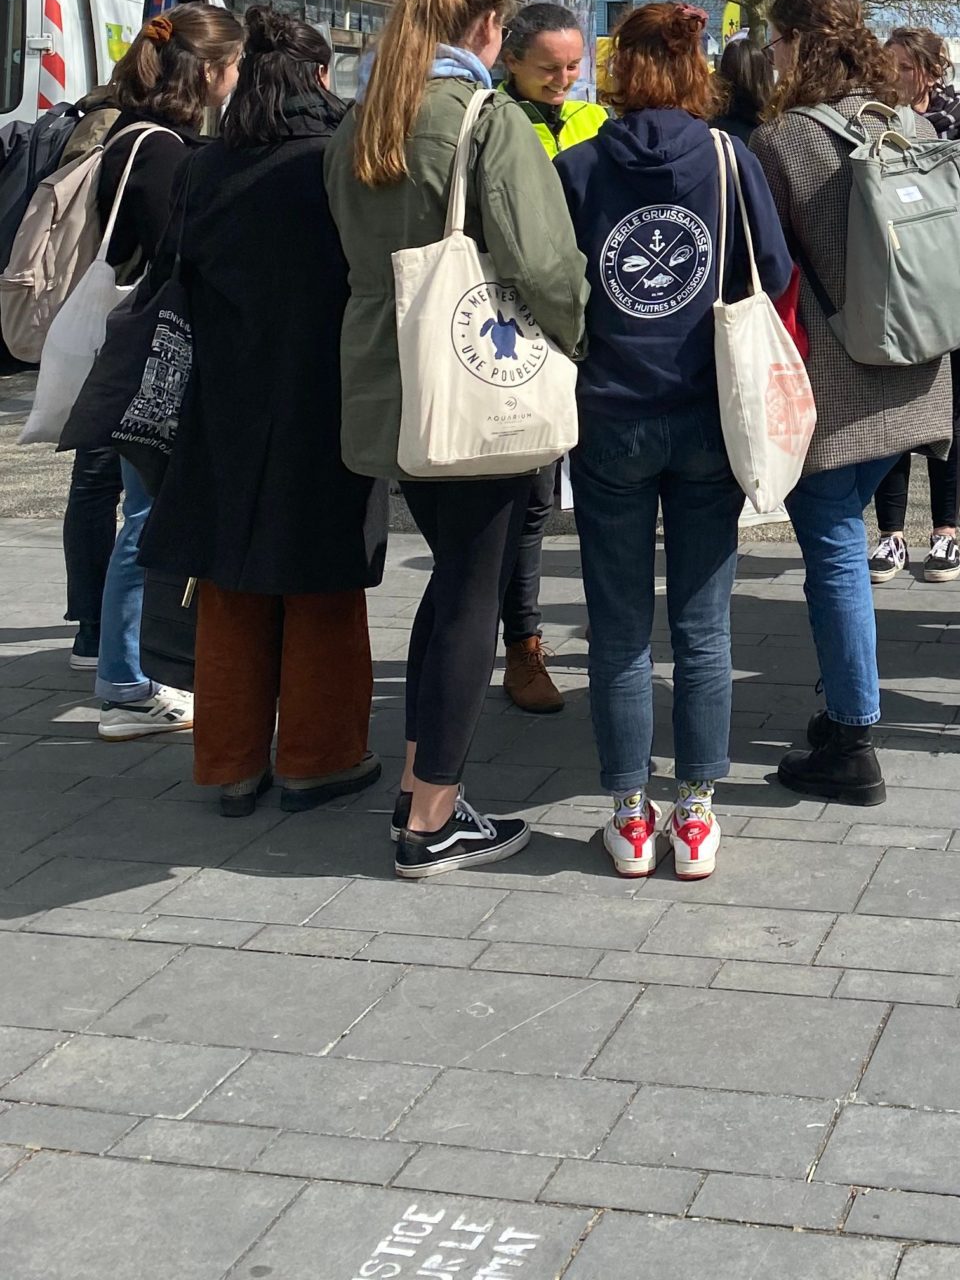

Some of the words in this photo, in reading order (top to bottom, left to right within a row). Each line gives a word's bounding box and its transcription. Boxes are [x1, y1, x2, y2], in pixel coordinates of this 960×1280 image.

[606, 249, 617, 266] LA
[612, 217, 642, 249] PERLE
[641, 209, 708, 252] GRUISSANAISE
[634, 301, 670, 313] HUITRES
[670, 299, 678, 307] &
[676, 266, 705, 303] POISSONS
[458, 311, 473, 326] LA
[519, 304, 536, 327] PAS
[461, 344, 487, 371] UNE
[490, 344, 544, 382] POUBELLE
[438, 1213, 494, 1251] LE
